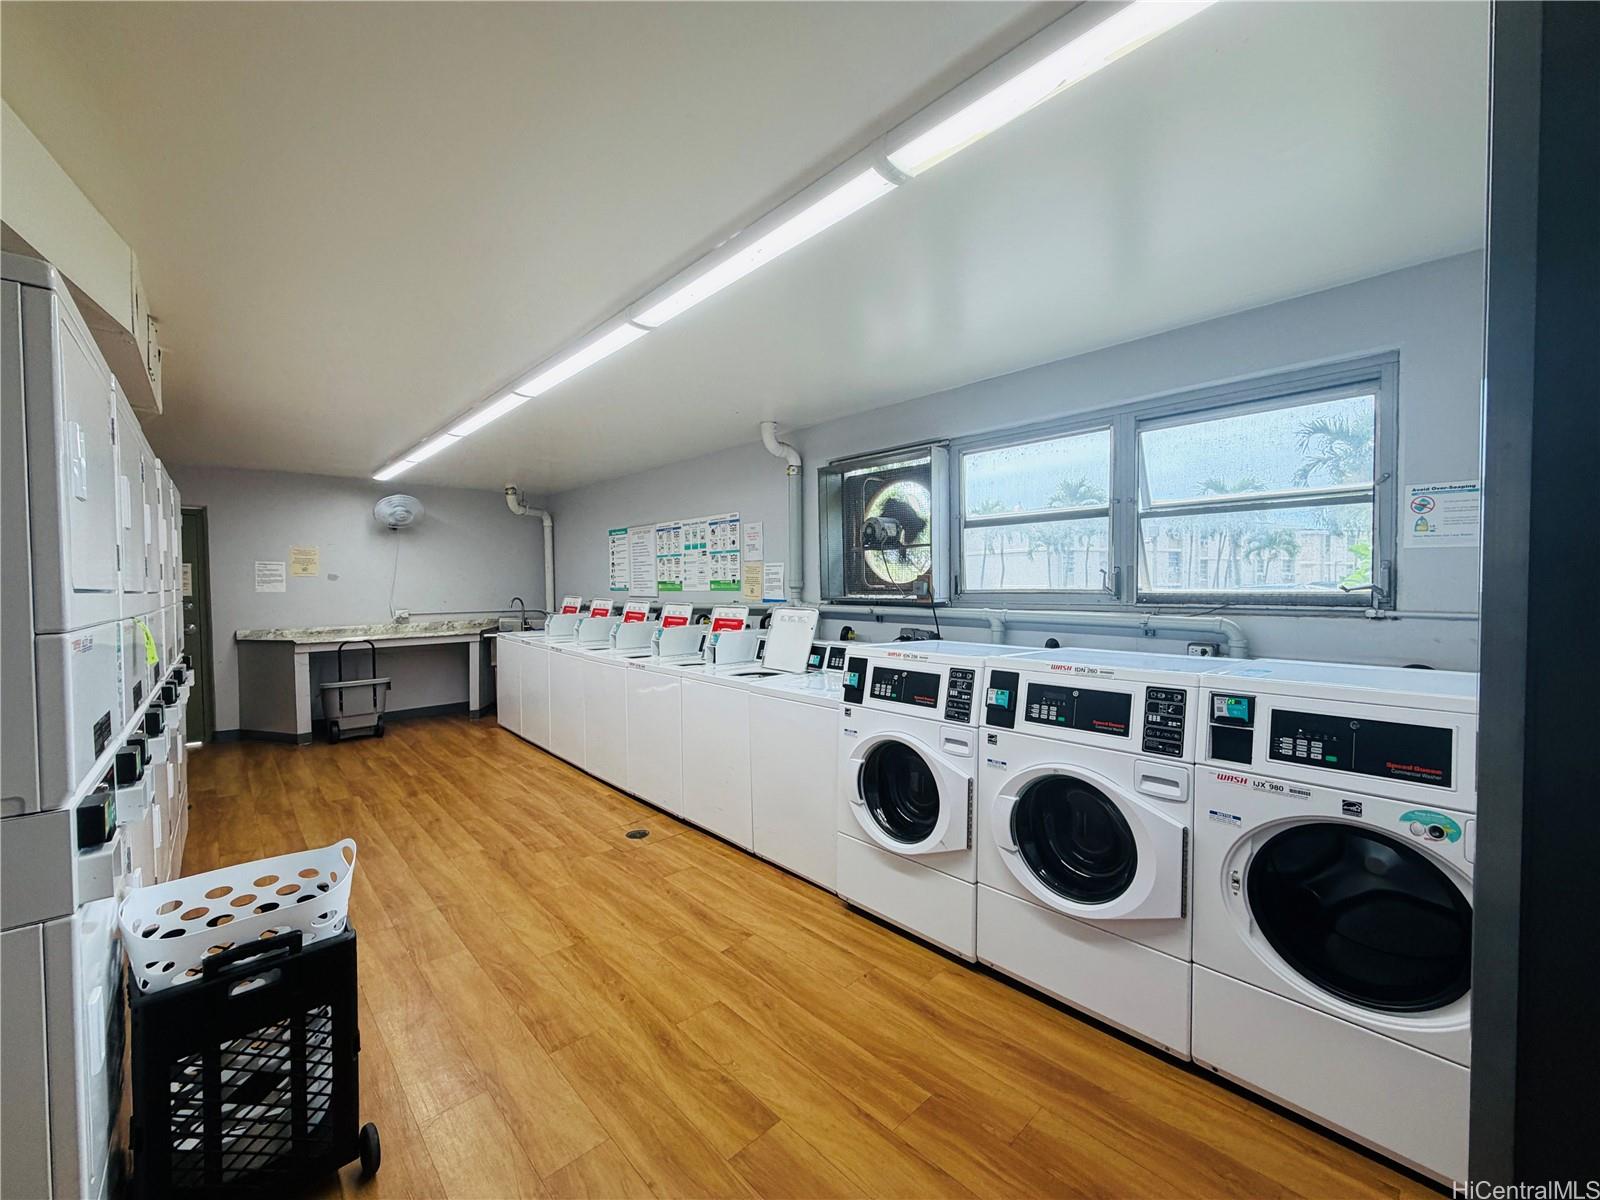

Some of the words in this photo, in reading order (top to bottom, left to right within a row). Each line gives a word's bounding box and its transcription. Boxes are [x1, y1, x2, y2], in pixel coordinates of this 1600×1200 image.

[1385, 761, 1413, 771] Speed
[1414, 766, 1443, 775] Queen
[1391, 768, 1421, 777] Commercial
[1216, 773, 1248, 785] WASH
[1269, 783, 1284, 792] 980
